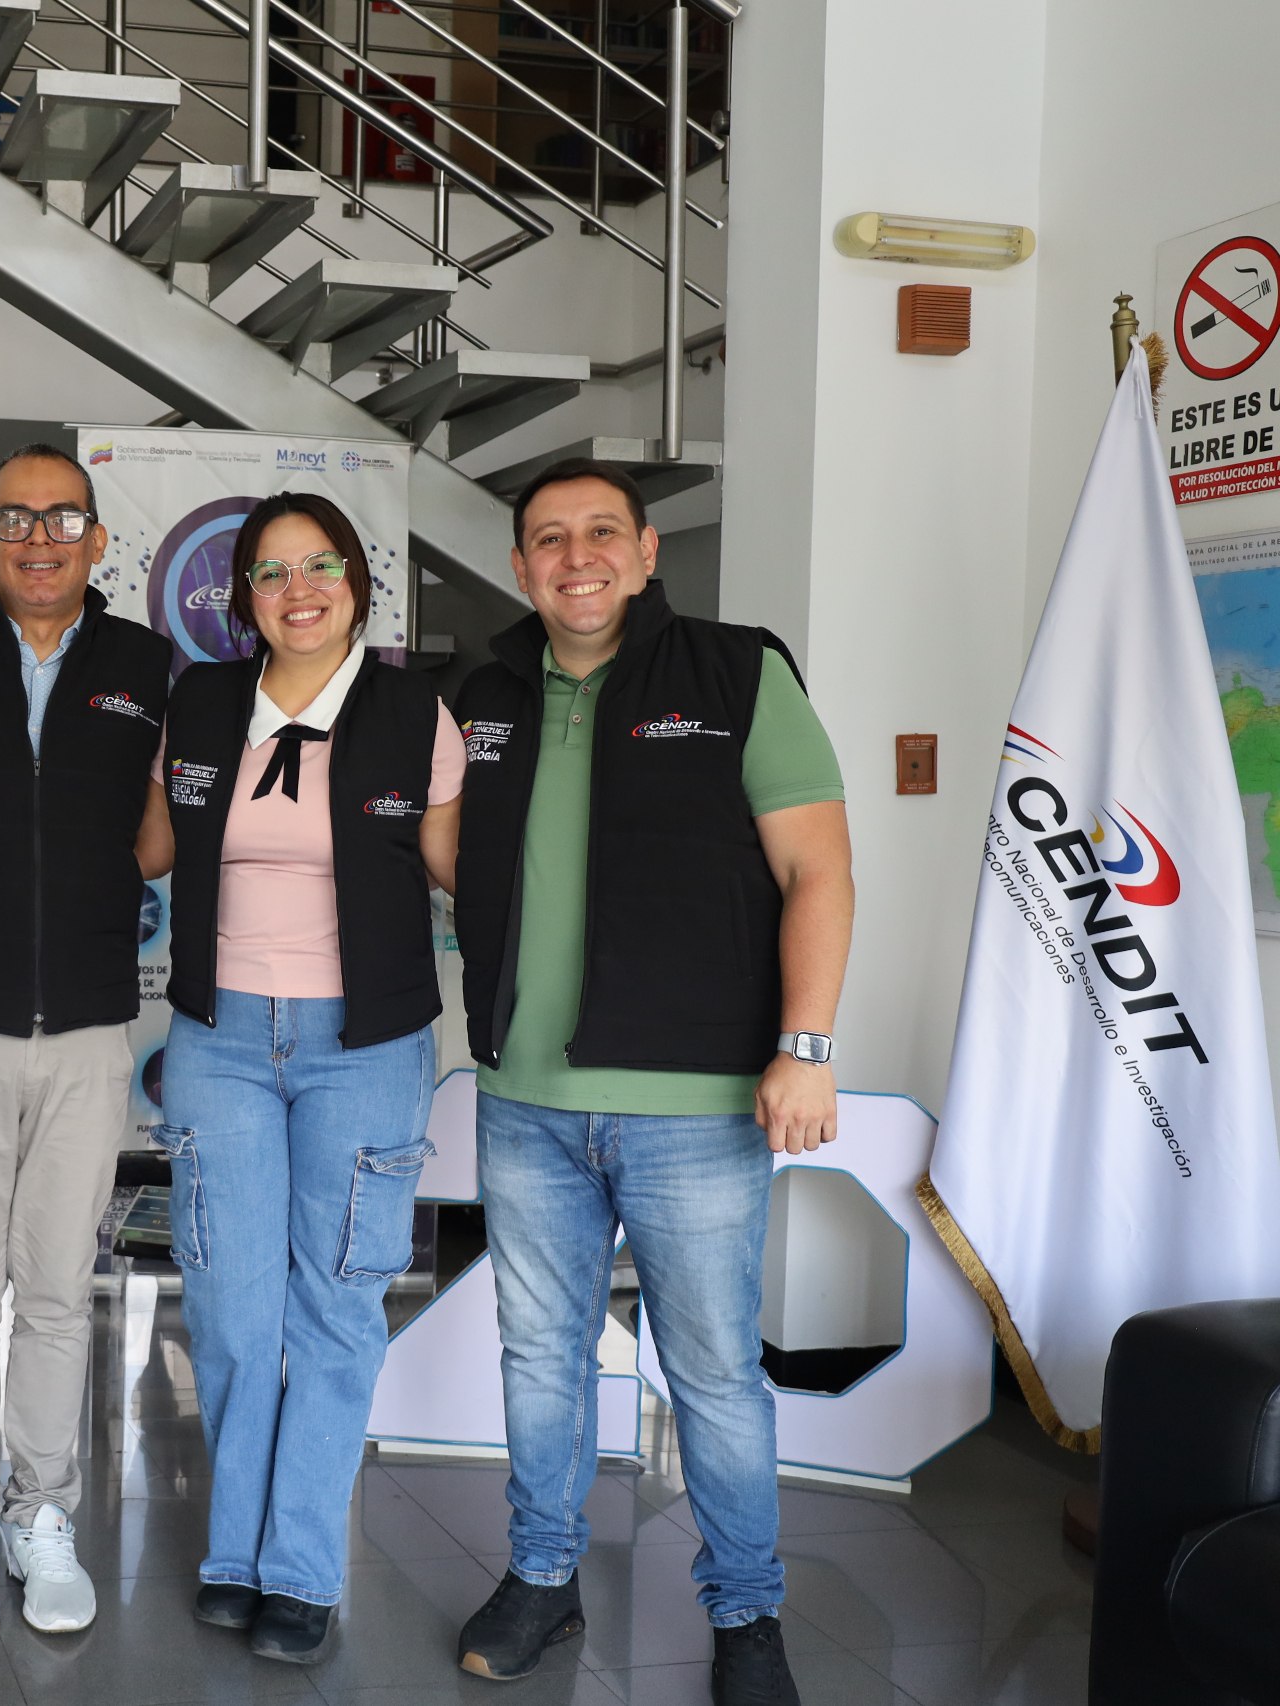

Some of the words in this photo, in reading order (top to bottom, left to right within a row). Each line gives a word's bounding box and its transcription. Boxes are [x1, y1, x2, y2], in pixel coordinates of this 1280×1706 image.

[1171, 399, 1226, 433] ESTE
[1233, 391, 1261, 420] ES
[1170, 434, 1235, 469] LIBRE
[1243, 426, 1274, 456] DE
[1178, 476, 1197, 488] POR
[1198, 464, 1256, 484] RESOLUCIÓN
[1257, 461, 1275, 474] DEL
[1180, 488, 1209, 502] SALUD
[1210, 486, 1217, 497] Y
[1217, 476, 1276, 496] PROTECCIÓN
[1208, 544, 1239, 553] OFICIAL
[1243, 541, 1253, 549] DE
[1257, 540, 1267, 548] LA
[105, 696, 145, 713] CENDIT
[473, 726, 511, 736] VENEZUELA
[649, 721, 702, 731] CENDIT
[483, 742, 491, 751] Y
[193, 786, 198, 796] Y
[377, 799, 412, 809] CENDIT
[1007, 776, 1210, 1065] CENDIT
[156, 965, 168, 974] DE
[143, 979, 155, 987] DE
[1006, 849, 1063, 922] Nacional
[1055, 926, 1075, 948] de
[1070, 951, 1118, 1041] Desarrollo
[1114, 1045, 1128, 1056] e
[1122, 1059, 1192, 1178] Investigación
